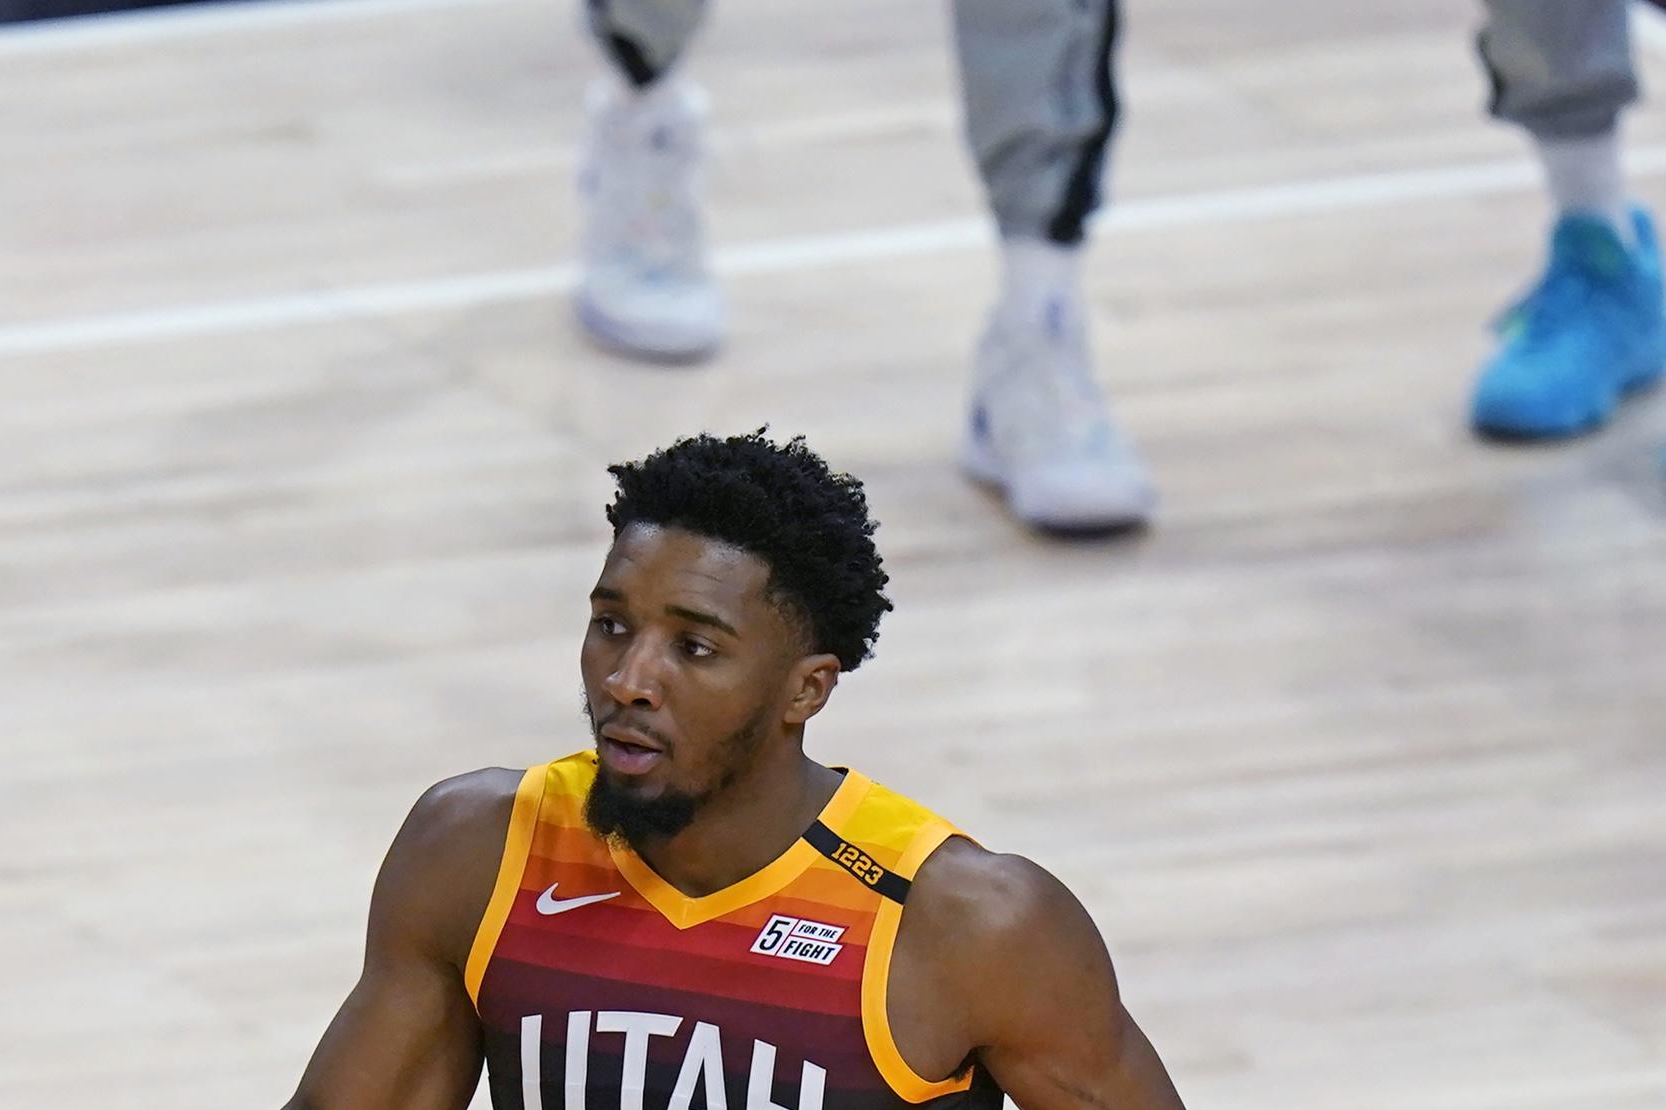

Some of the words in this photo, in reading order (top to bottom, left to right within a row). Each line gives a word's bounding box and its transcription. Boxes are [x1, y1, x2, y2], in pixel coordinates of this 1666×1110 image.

[831, 842, 884, 886] 1223
[759, 919, 790, 951] 5
[797, 924, 817, 935] FOR
[820, 927, 838, 939] THE
[783, 940, 836, 961] FIGHT
